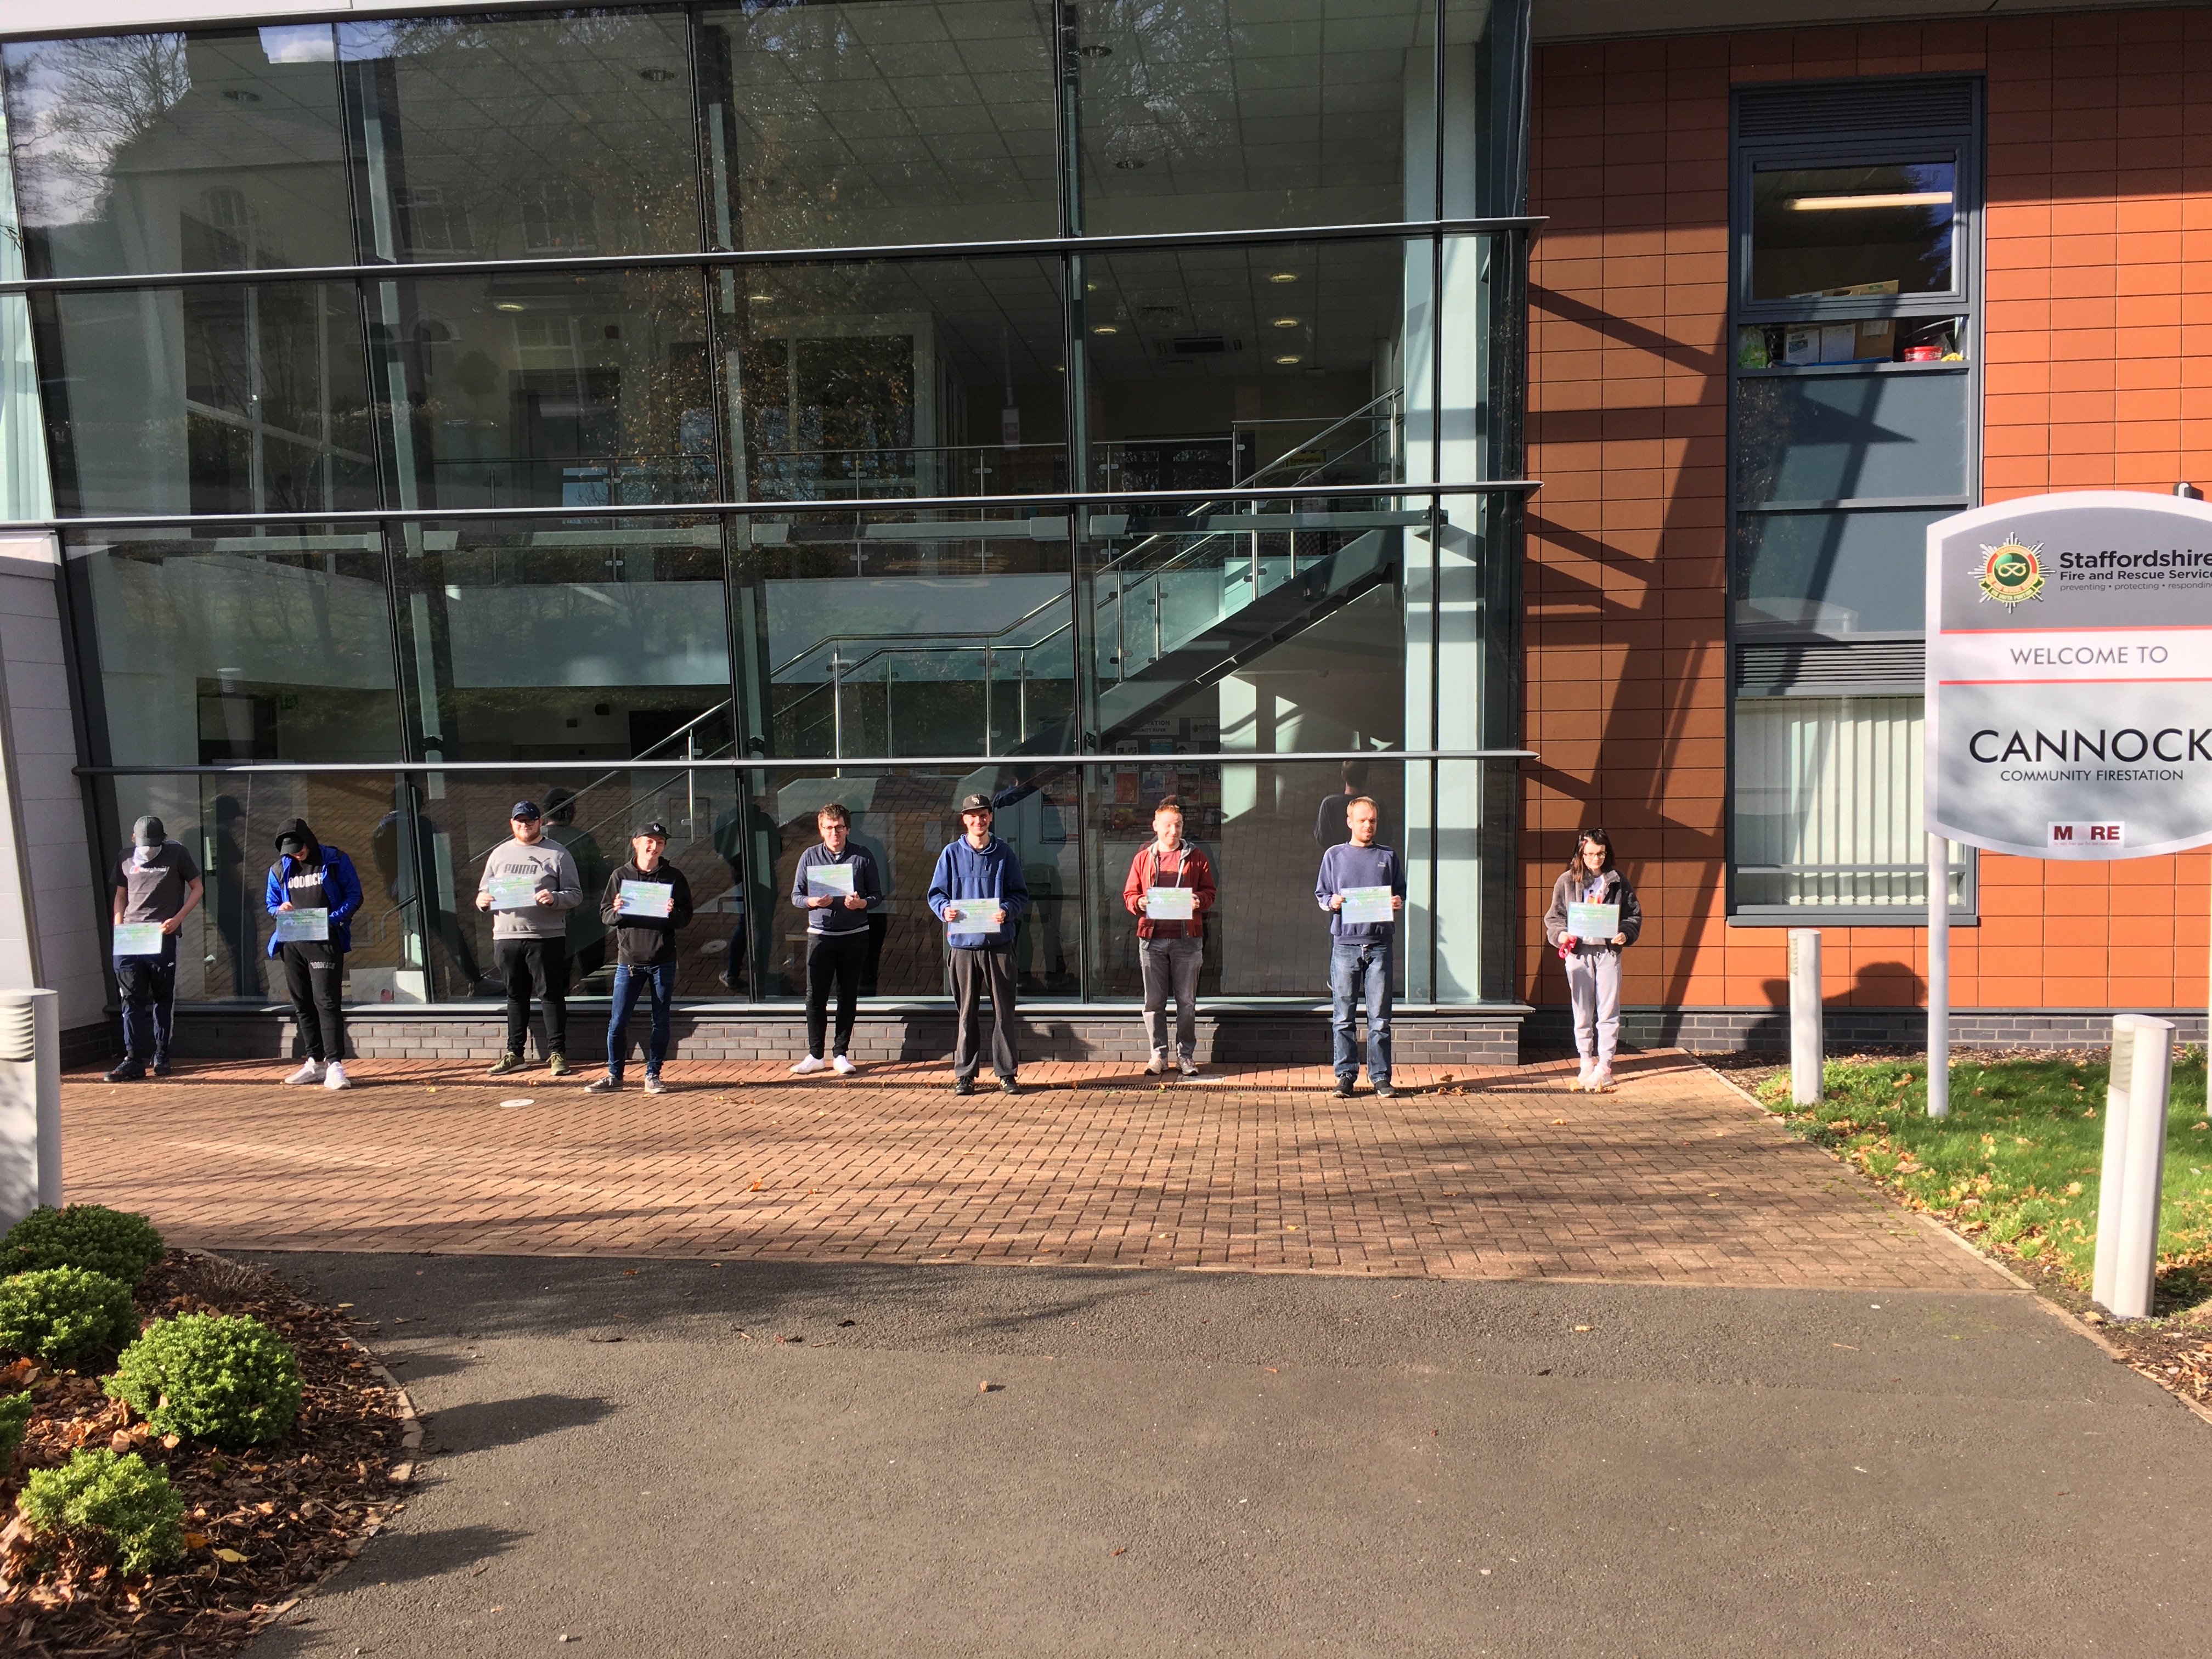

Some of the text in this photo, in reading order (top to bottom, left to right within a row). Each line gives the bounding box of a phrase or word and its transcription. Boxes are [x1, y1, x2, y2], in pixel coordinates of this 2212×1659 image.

[2060, 549, 2212, 568] Staffordshire
[2061, 571, 2085, 580] Fire
[2089, 571, 2113, 580] and
[2118, 571, 2164, 579] Rescue
[2115, 582, 2159, 591] protecting
[2010, 646, 2168, 665] WELCOME TO
[1970, 729, 2212, 763] CANNOCK
[2001, 770, 2183, 781] COMMUNITY FIRESTATION
[504, 864, 538, 874] PUMA
[287, 873, 323, 888] OODRICH
